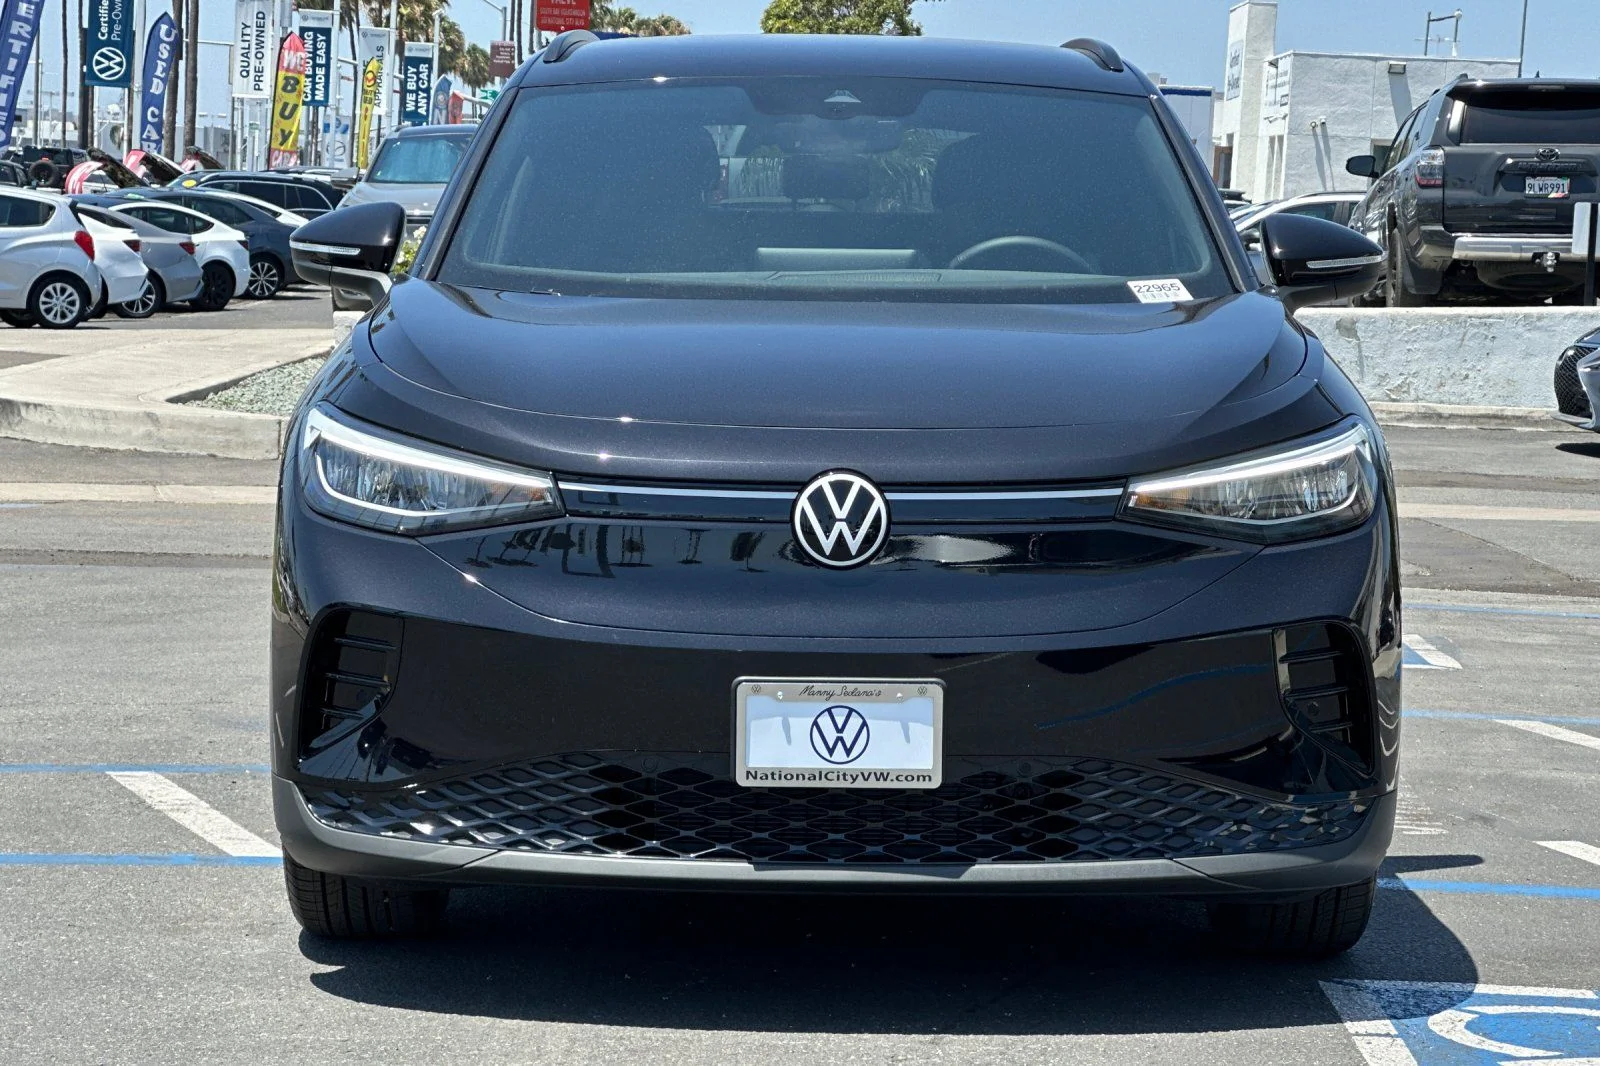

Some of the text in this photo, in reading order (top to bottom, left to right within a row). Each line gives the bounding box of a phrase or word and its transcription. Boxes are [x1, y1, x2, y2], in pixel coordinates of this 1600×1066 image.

[0, 0, 41, 143] ERTIFIED
[150, 24, 177, 95] USED
[240, 22, 251, 78] QUALITY
[254, 10, 266, 91] PRE-OWNED
[302, 31, 314, 101] CAR BUYING
[315, 33, 326, 101] MADE EASY
[279, 76, 300, 146] BUY
[406, 66, 417, 111] WE BUY
[418, 64, 429, 115] ANY CAR
[1133, 283, 1181, 293] 22965
[799, 685, 836, 701] Manny
[745, 770, 932, 784] NationalCityVW.com
